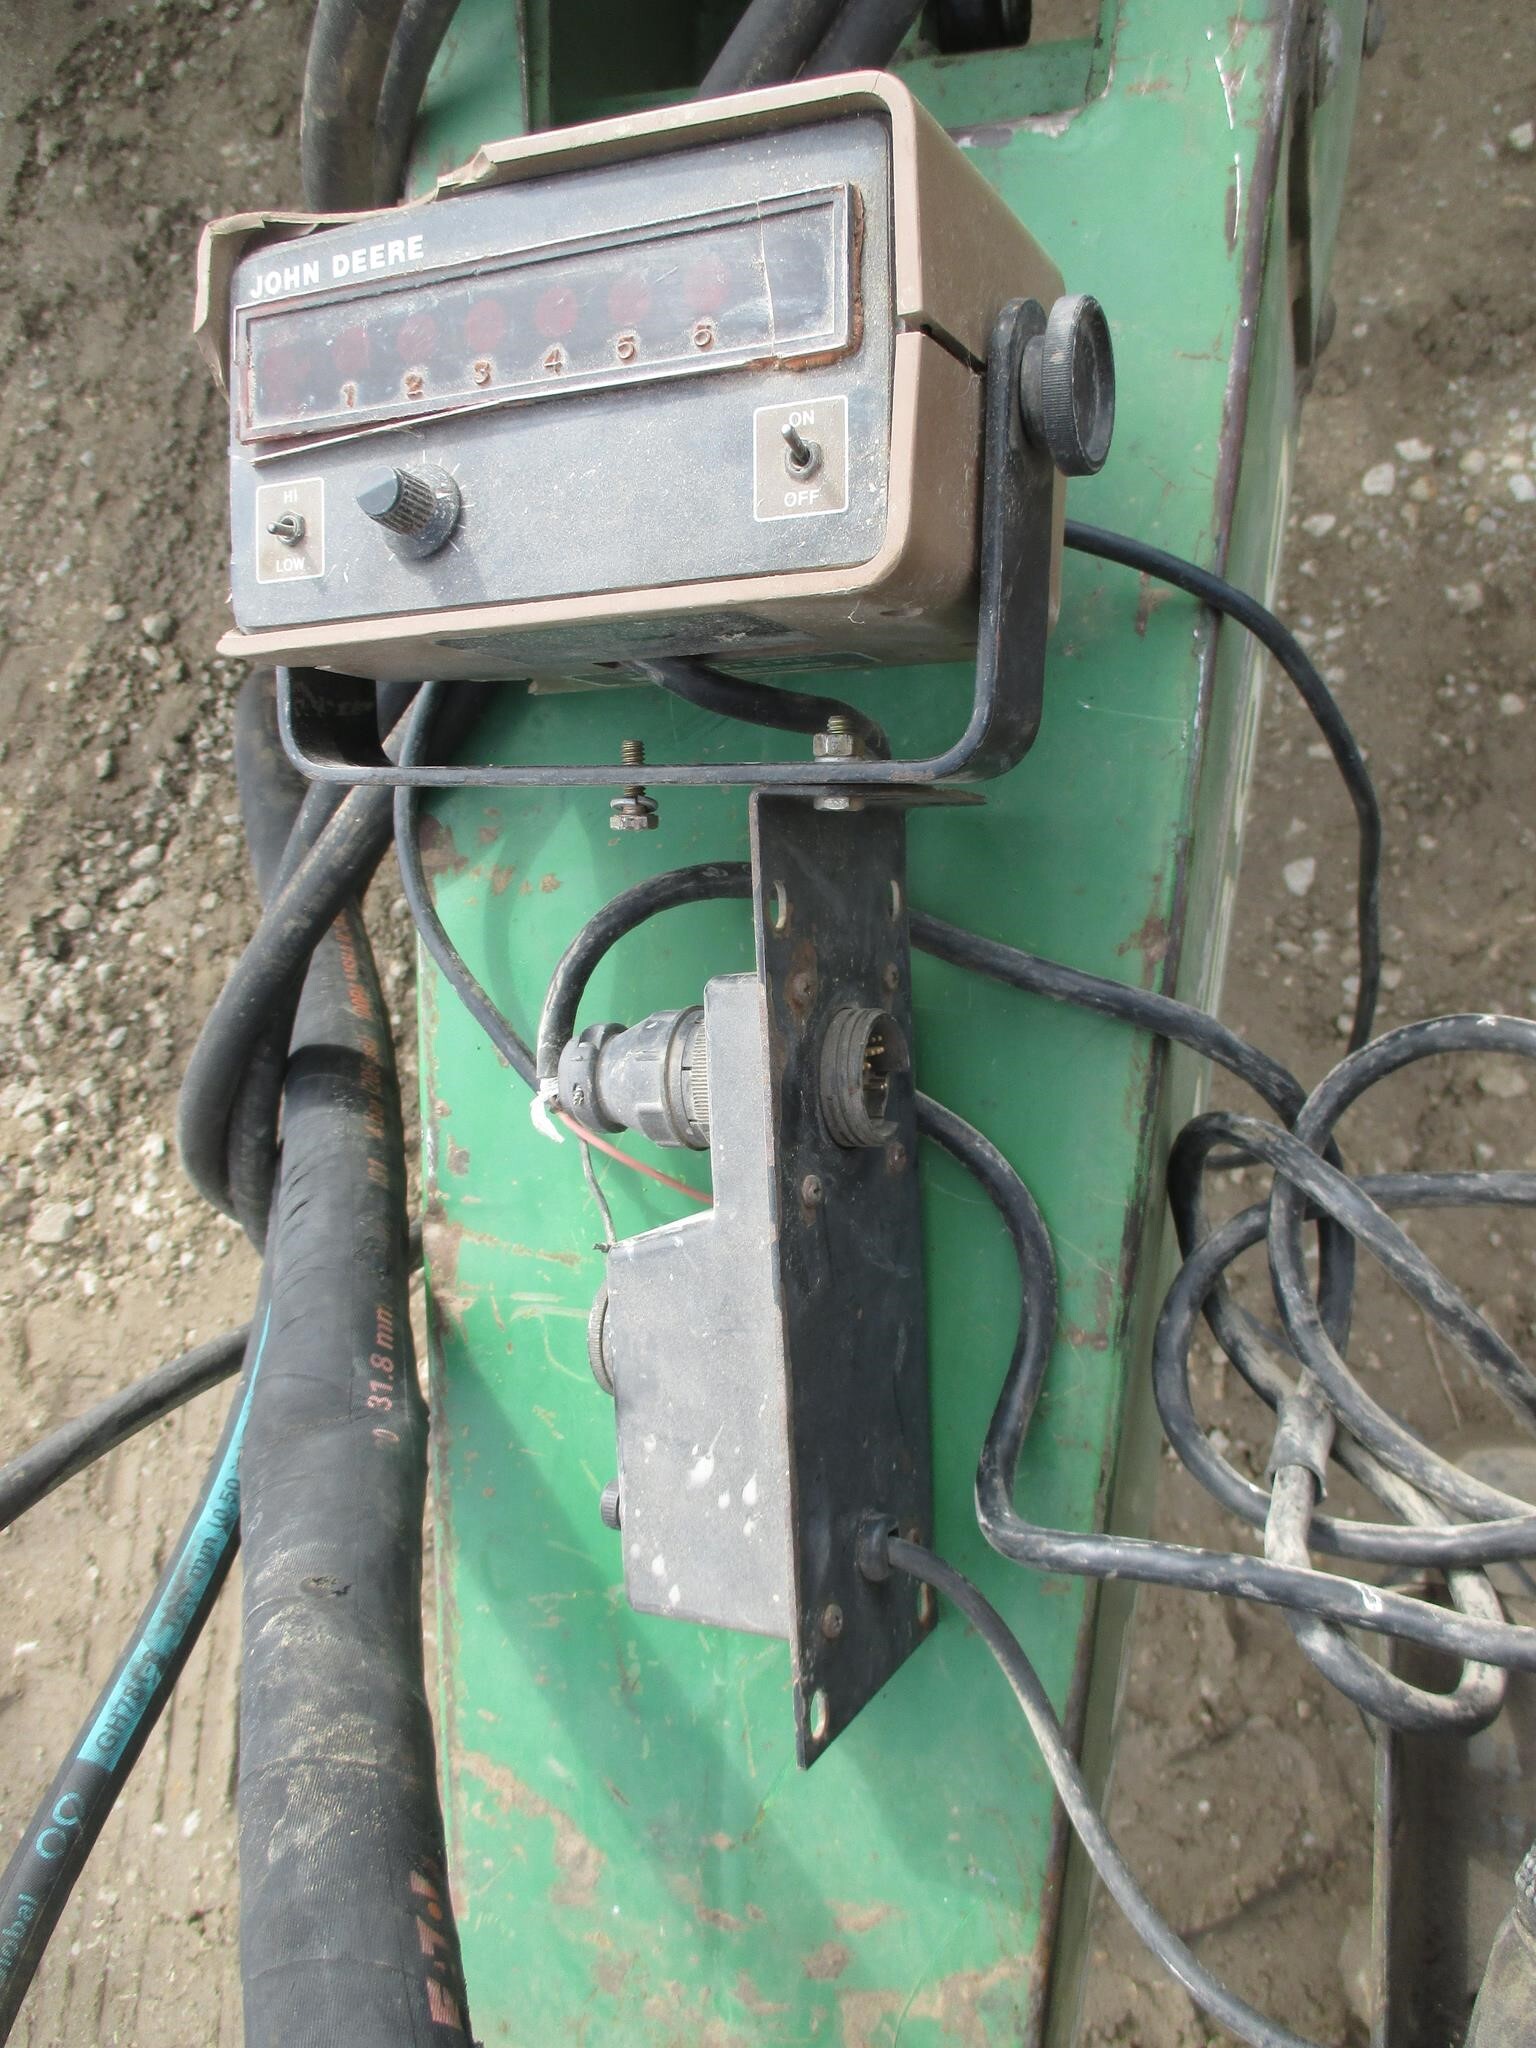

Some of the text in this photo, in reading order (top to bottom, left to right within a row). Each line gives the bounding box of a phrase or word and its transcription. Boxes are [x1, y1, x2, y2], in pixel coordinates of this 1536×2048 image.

[250, 235, 425, 299] JOHN DEERE
[341, 383, 356, 408] 1
[405, 371, 424, 397] 2
[473, 358, 492, 386] 3
[543, 348, 562, 375] 4
[693, 322, 713, 347] 6
[788, 409, 815, 428] ON
[283, 489, 298, 504] HI
[783, 488, 820, 508] OFF
[275, 556, 305, 573] LOW
[375, 1303, 395, 1351] mm
[366, 1352, 395, 1412] 31.8
